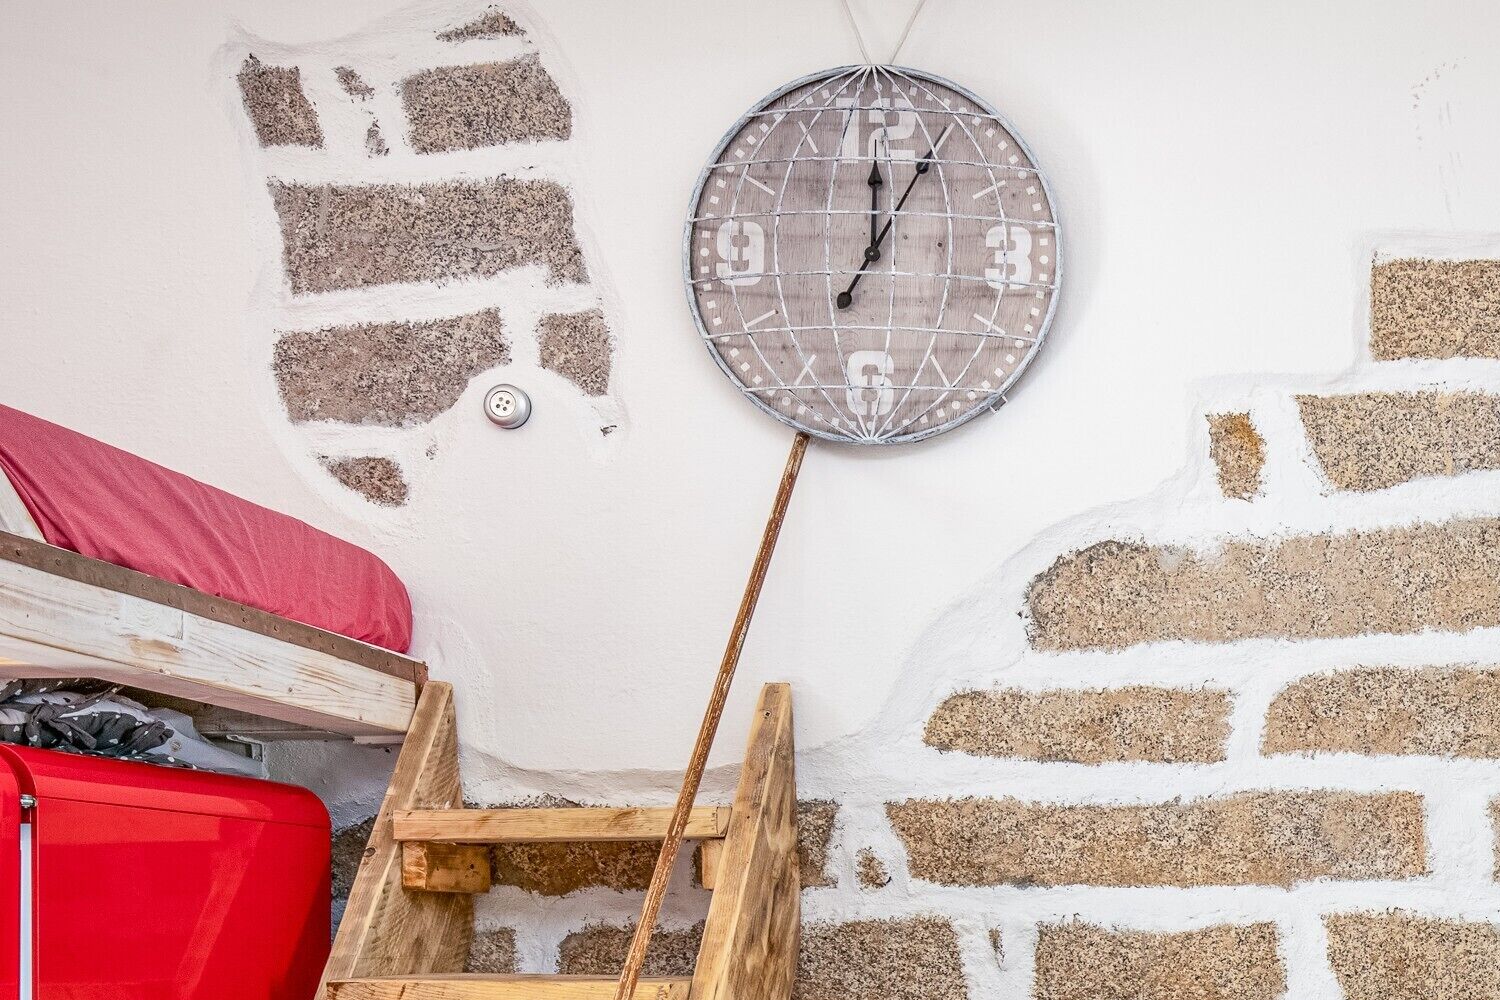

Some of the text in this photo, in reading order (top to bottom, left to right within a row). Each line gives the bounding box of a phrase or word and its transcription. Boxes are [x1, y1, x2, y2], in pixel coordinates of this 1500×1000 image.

[834, 97, 916, 164] 12
[716, 221, 765, 286] 9
[984, 226, 1032, 290] 3
[847, 350, 894, 415] 6
